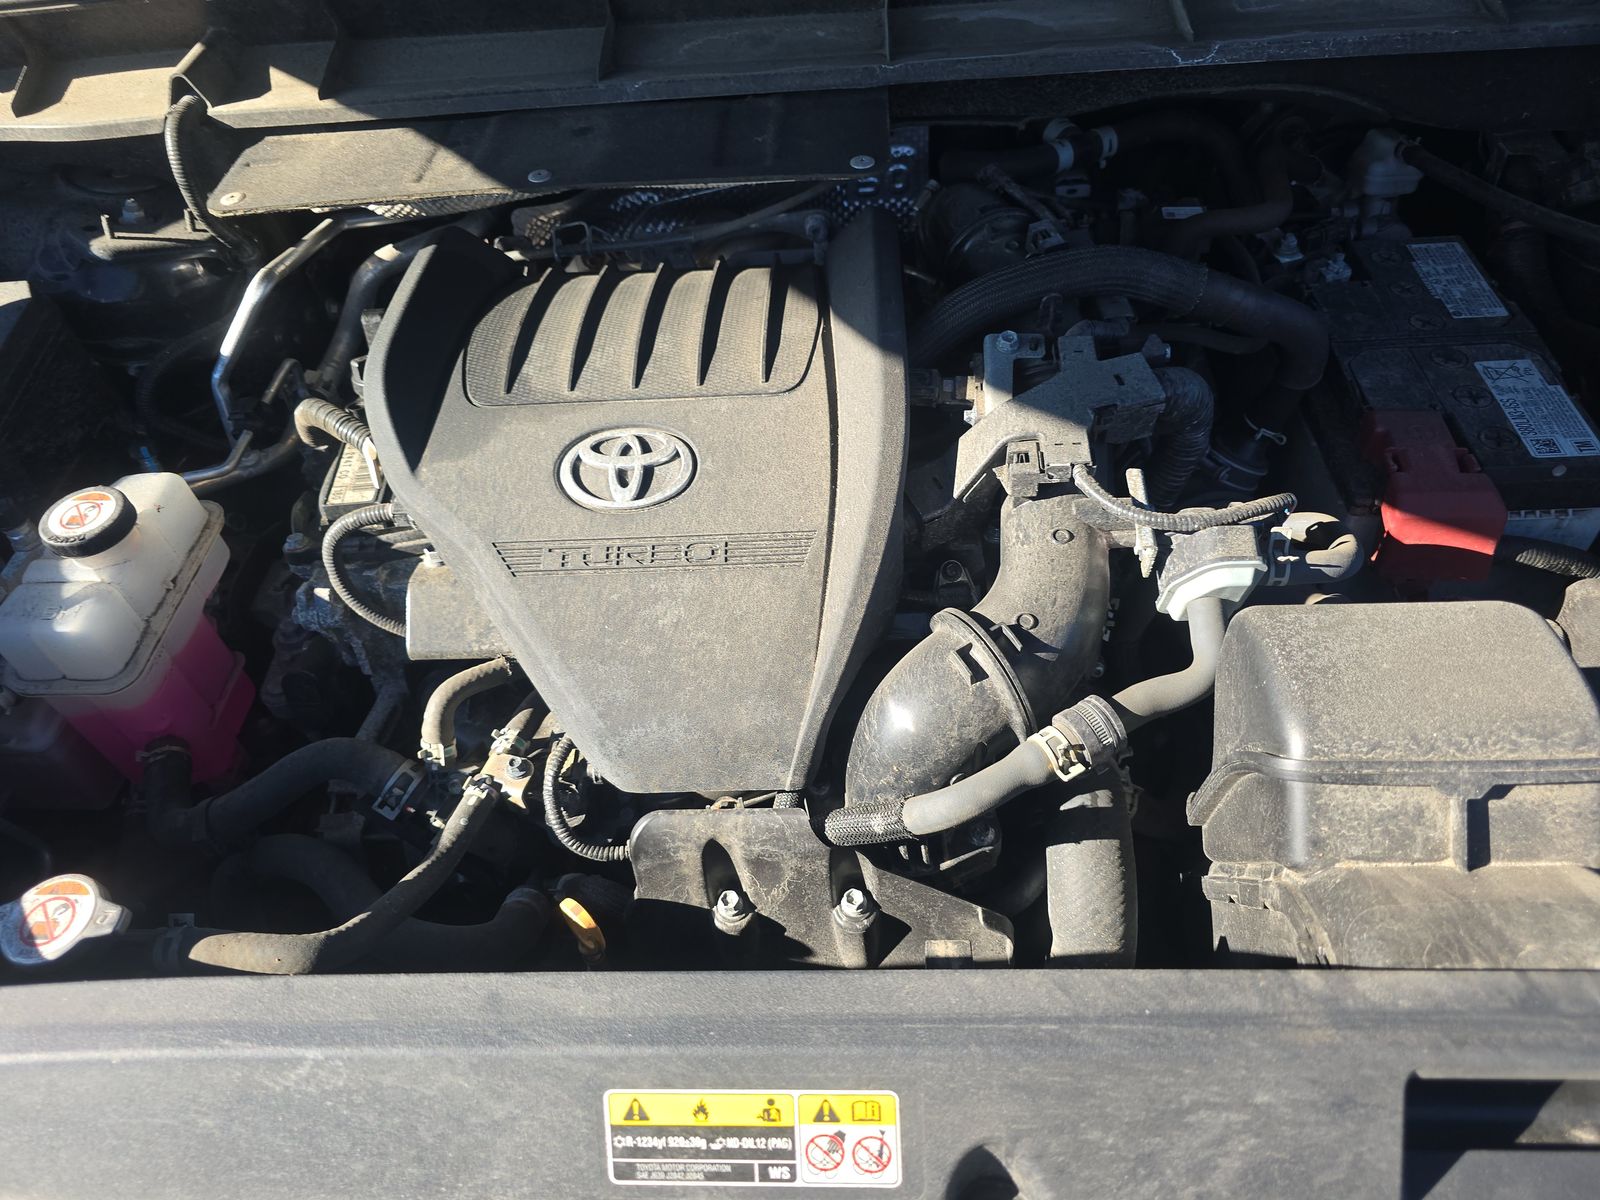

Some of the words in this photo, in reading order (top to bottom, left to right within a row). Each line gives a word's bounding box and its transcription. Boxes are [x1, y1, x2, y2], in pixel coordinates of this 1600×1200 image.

[548, 541, 720, 568] TURBO
[636, 1163, 661, 1172] TOYOTA
[661, 1163, 685, 1172] MOTOR
[685, 1163, 732, 1173] CORPORATION
[767, 1166, 791, 1180] WS
